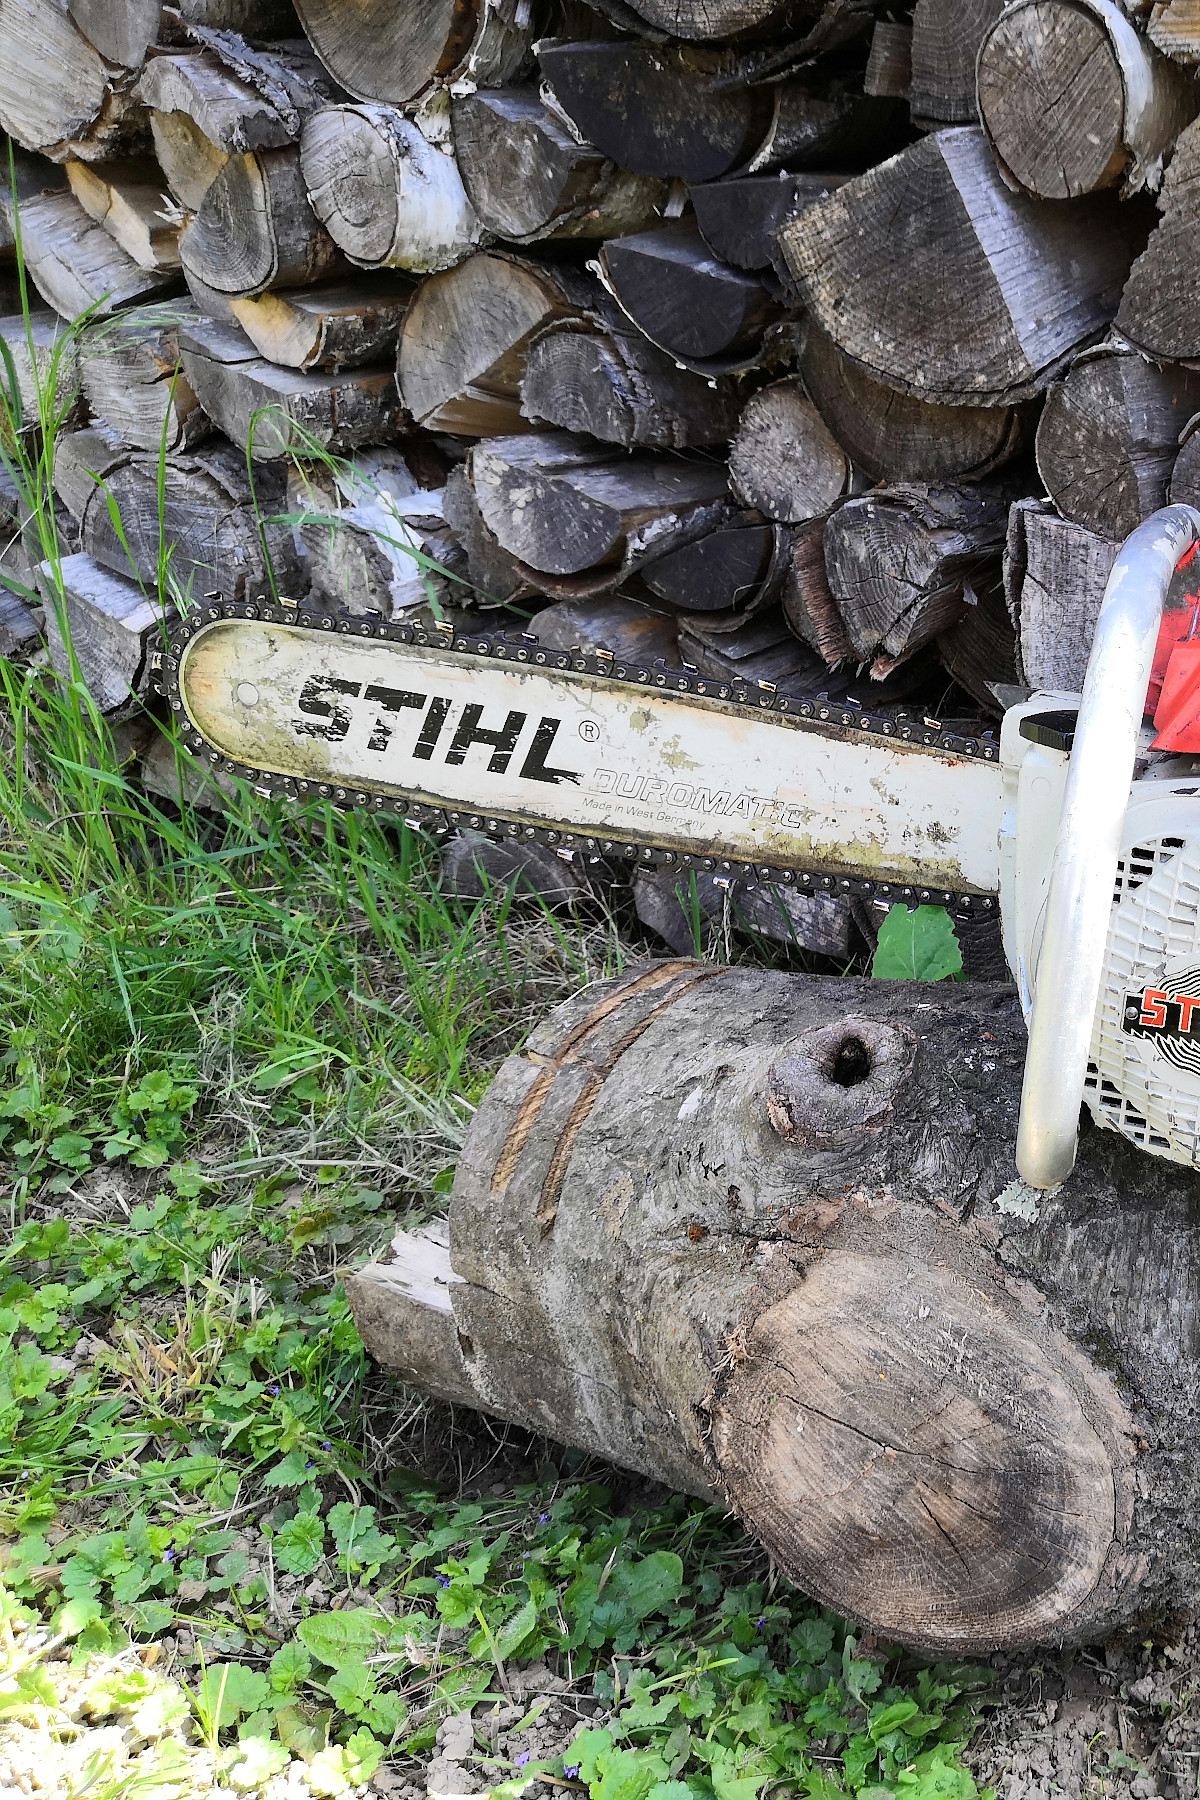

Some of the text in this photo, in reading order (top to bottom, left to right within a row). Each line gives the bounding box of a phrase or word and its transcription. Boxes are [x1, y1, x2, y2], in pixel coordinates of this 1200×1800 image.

[292, 673, 585, 786] STIHL
[582, 797, 705, 829] Made in West Germany
[589, 768, 807, 829] DUROMATIC
